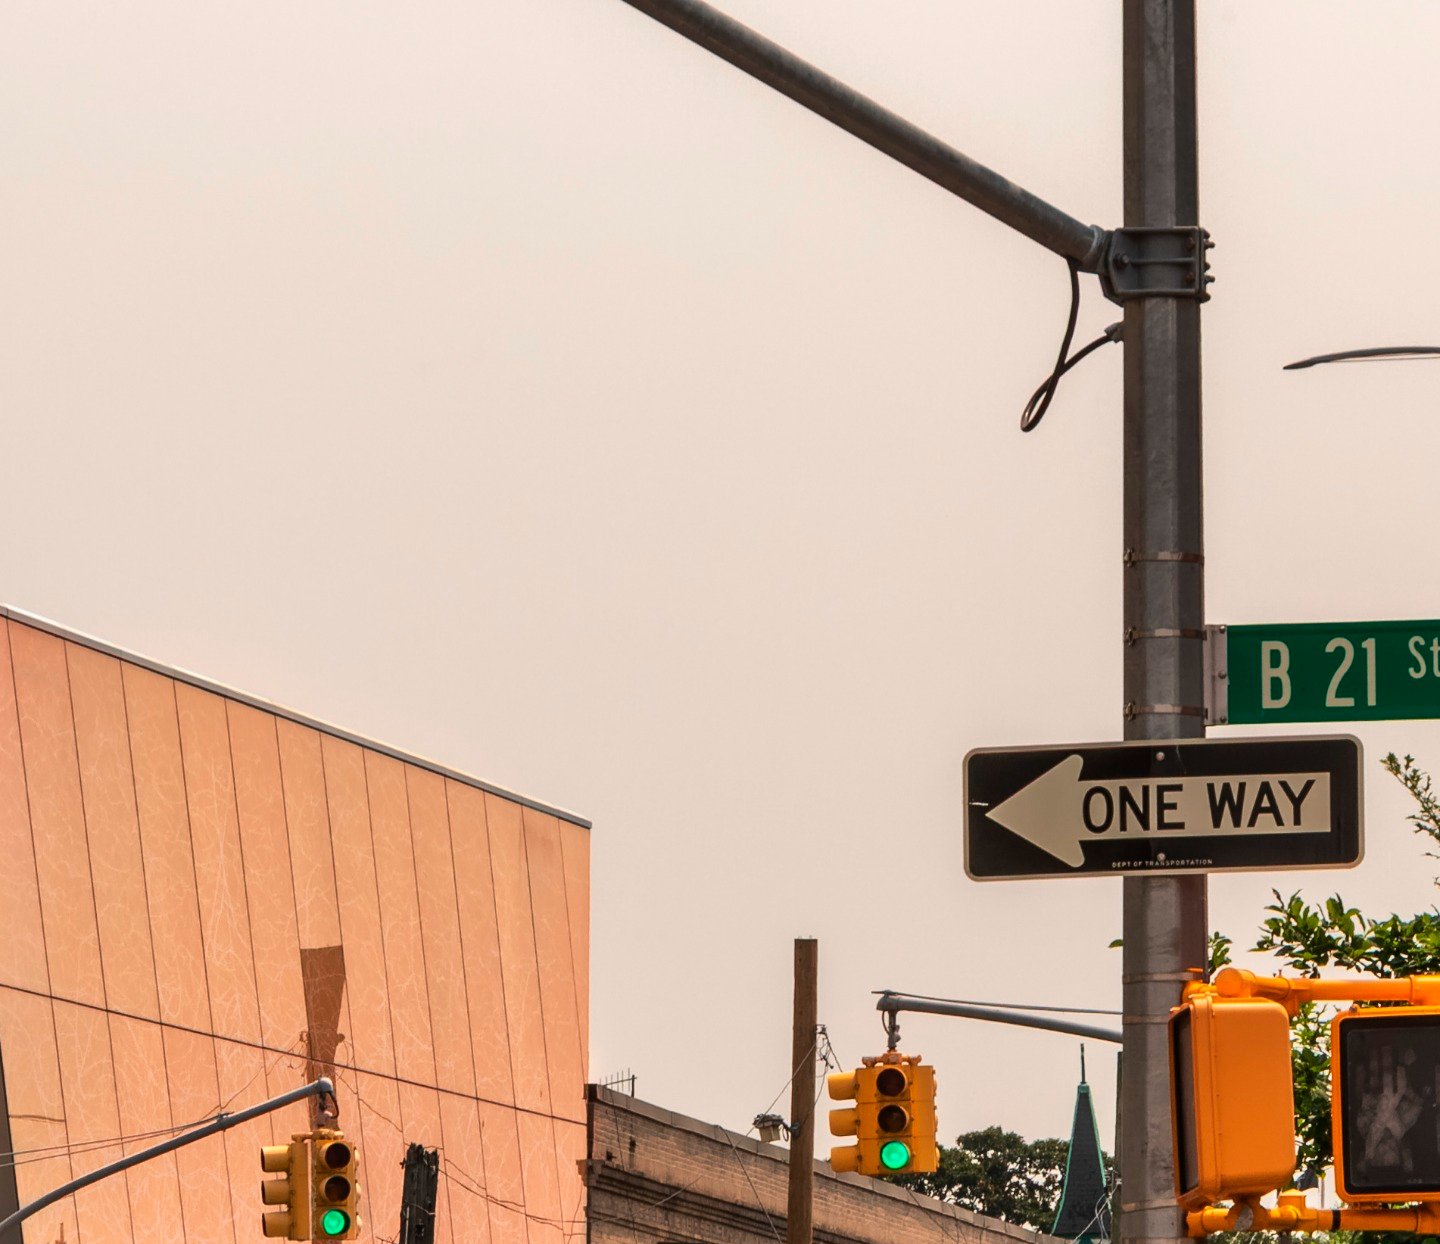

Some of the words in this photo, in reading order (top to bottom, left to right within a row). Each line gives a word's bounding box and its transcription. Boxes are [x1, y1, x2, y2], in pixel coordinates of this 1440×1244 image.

[1261, 639, 1293, 710] B
[1325, 637, 1378, 708] 21
[1082, 782, 1186, 835] ONE
[1205, 777, 1318, 830] WAY
[1111, 860, 1131, 868] DEPT
